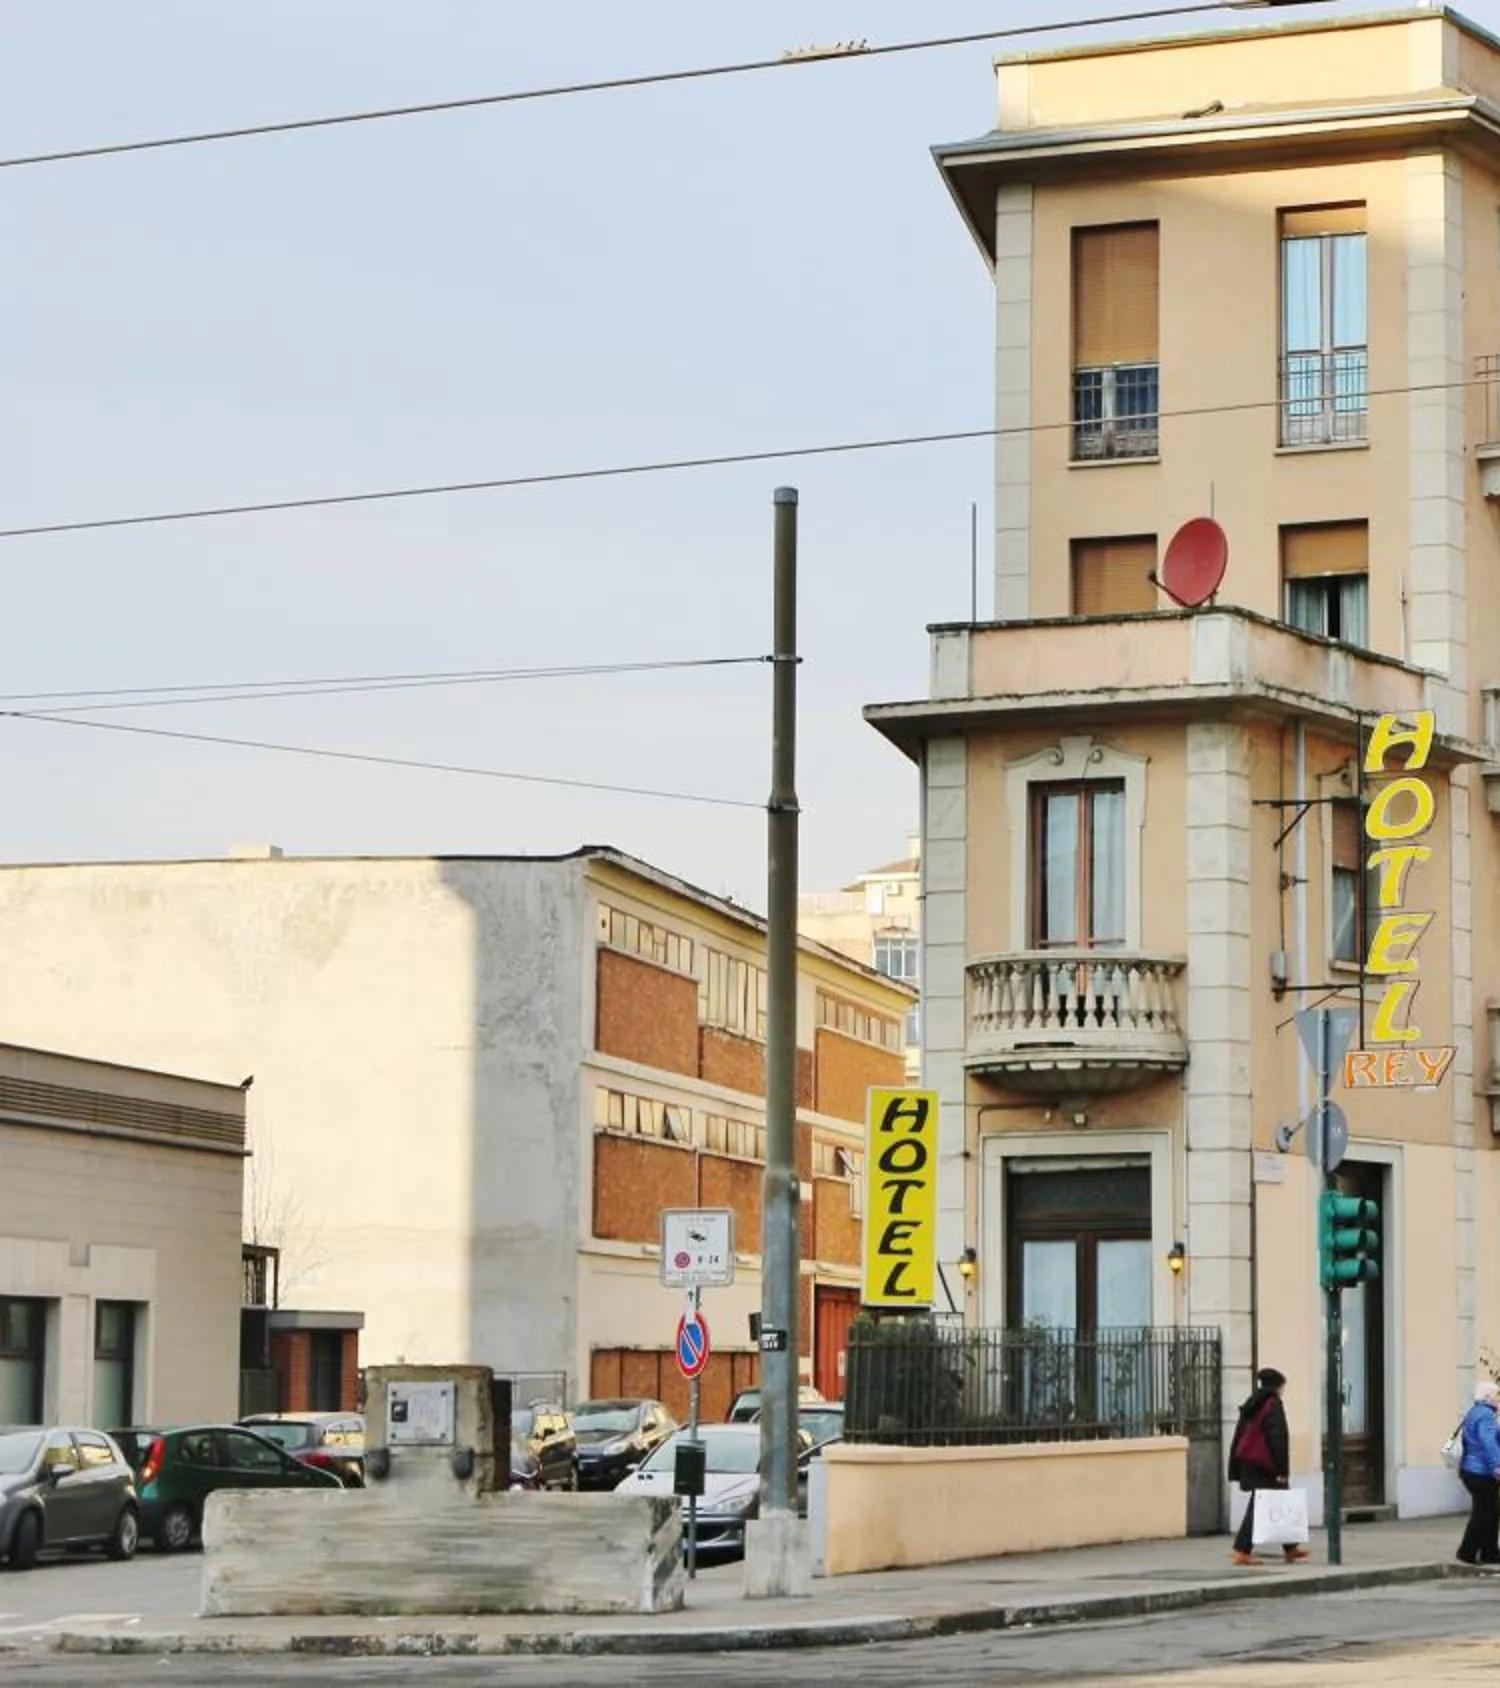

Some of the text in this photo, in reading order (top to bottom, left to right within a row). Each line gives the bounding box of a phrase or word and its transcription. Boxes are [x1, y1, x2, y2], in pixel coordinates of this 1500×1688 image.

[1363, 709, 1435, 1043] HOTEL
[1345, 1049, 1452, 1088] REY
[877, 1097, 930, 1297] HOTEL
